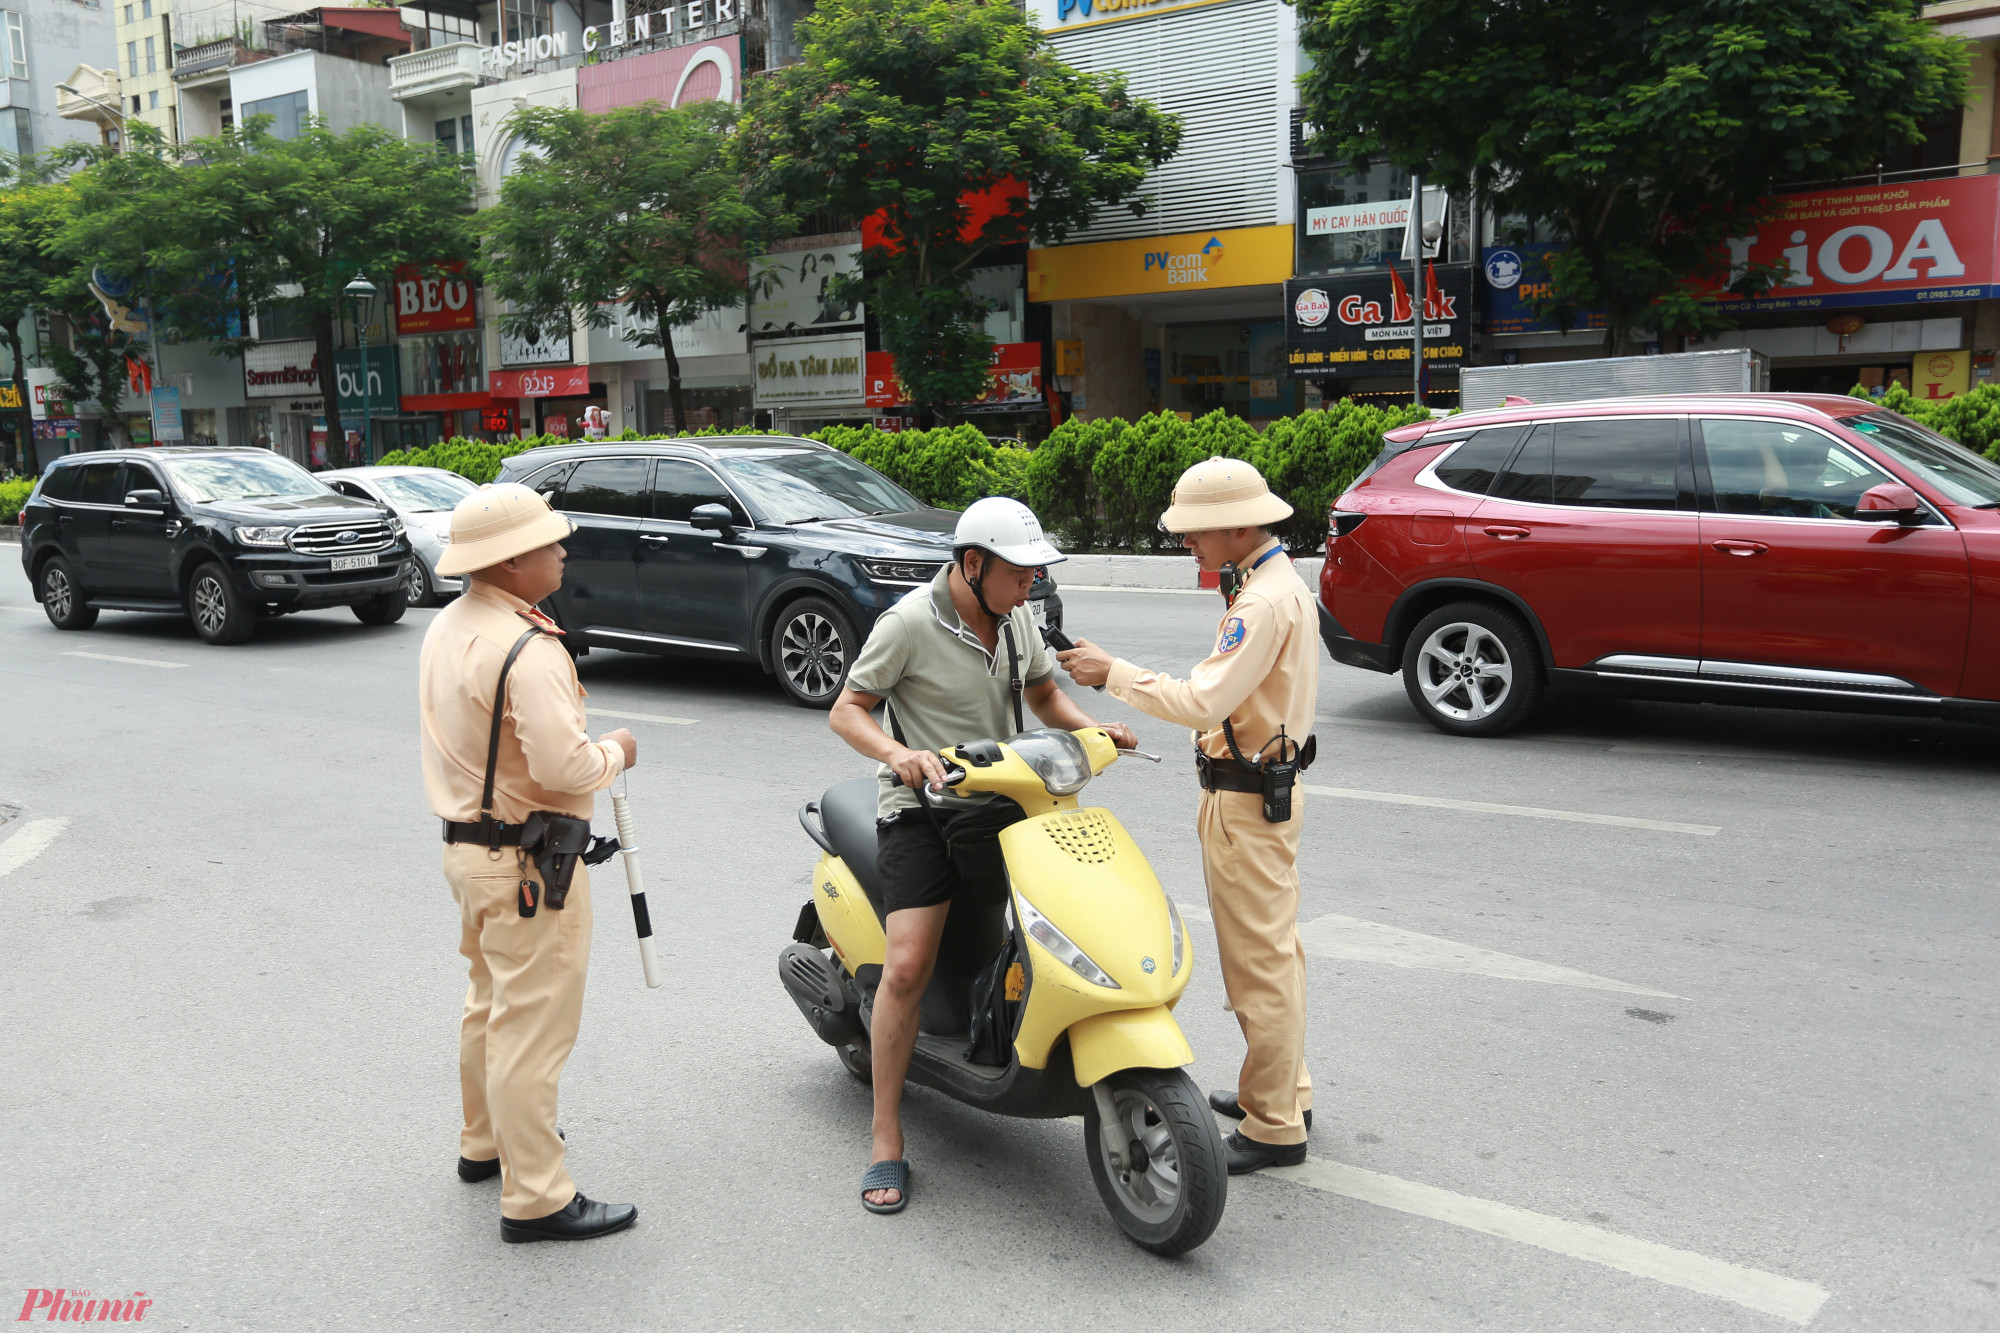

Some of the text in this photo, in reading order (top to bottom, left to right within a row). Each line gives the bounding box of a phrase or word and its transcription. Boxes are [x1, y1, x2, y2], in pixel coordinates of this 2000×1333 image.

[479, 0, 734, 72] FASHION CENTER
[1827, 196, 1853, 205] TNHH
[1855, 193, 1880, 202] MINH
[1331, 215, 1350, 229] CAY
[1354, 211, 1376, 227] HÀN
[1379, 206, 1408, 225] QUỐC
[1168, 268, 1208, 284] Bank
[1296, 303, 1309, 311] Ga
[1338, 294, 1384, 325] Ga
[831, 357, 859, 375] ANH
